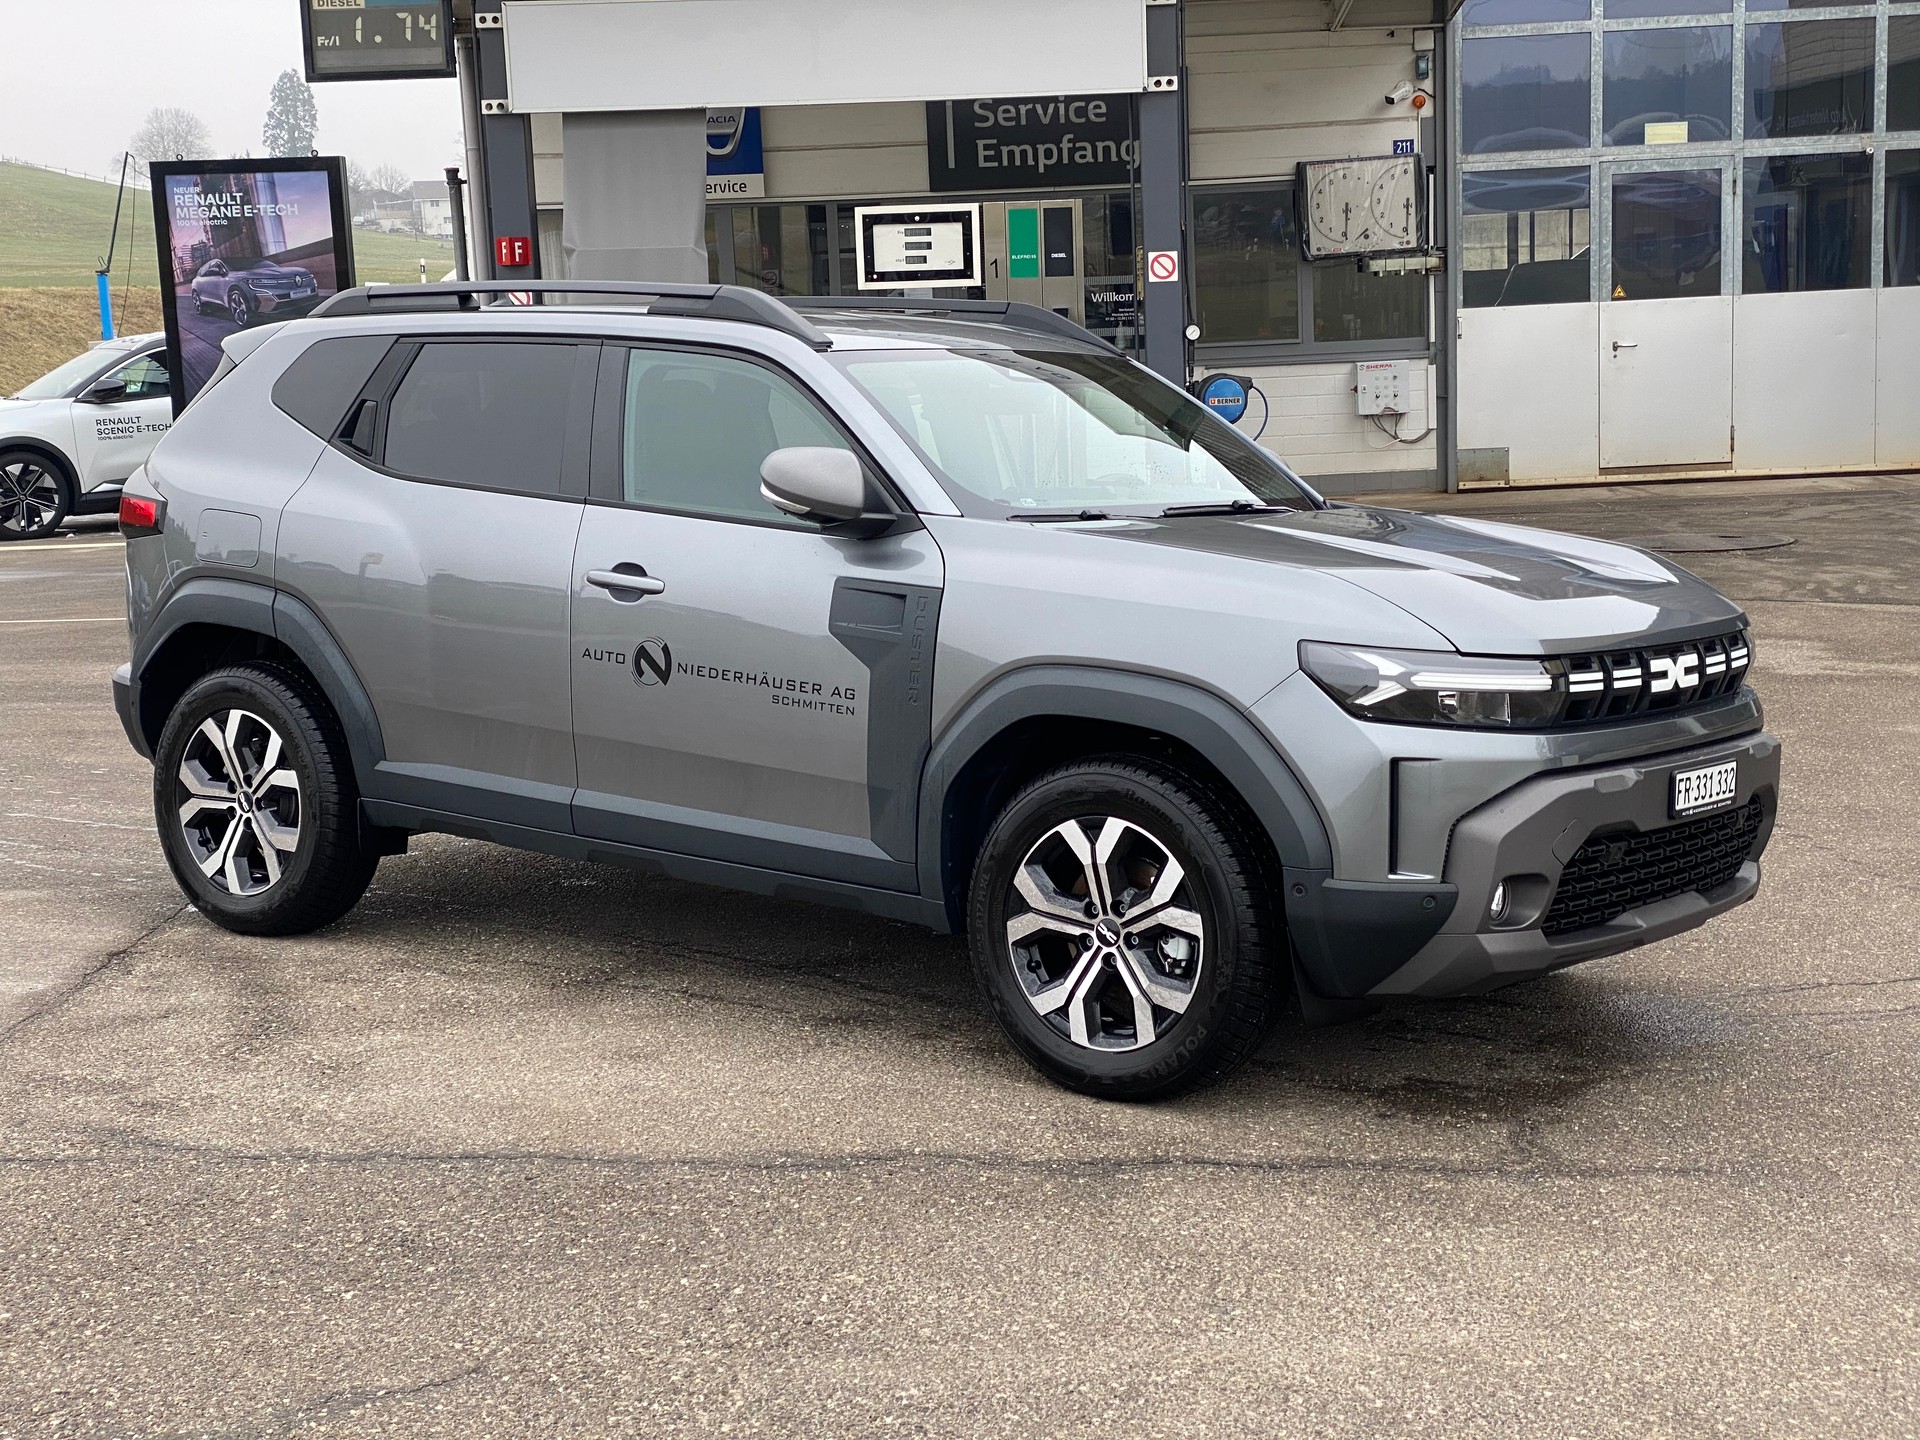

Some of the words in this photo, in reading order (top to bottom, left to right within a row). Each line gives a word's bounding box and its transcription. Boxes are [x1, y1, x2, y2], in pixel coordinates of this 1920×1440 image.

[355, 12, 437, 43] 1.74
[973, 96, 1107, 127] Service
[706, 115, 737, 124] ACIA
[976, 133, 1140, 174] Empfang
[1397, 141, 1411, 153] 211
[705, 180, 747, 194] ervice
[174, 193, 243, 207] RENAULT
[176, 205, 241, 219] MEGANE
[244, 203, 299, 217] E-TECH
[177, 219, 198, 227] 100%
[199, 218, 228, 226] electric
[514, 241, 523, 262] F
[990, 257, 999, 279] 1
[1091, 291, 1143, 302] Willkom
[1216, 397, 1241, 405] BERNER
[96, 416, 141, 426] RENAULT
[97, 426, 135, 435] SCENIC
[137, 423, 172, 432] E-TECH
[907, 595, 929, 706] DUSTER
[581, 648, 626, 665] AUTO
[676, 661, 823, 697] NIEDERHÄUSER
[830, 685, 857, 701] AG
[771, 694, 856, 717] SCHMITTEN
